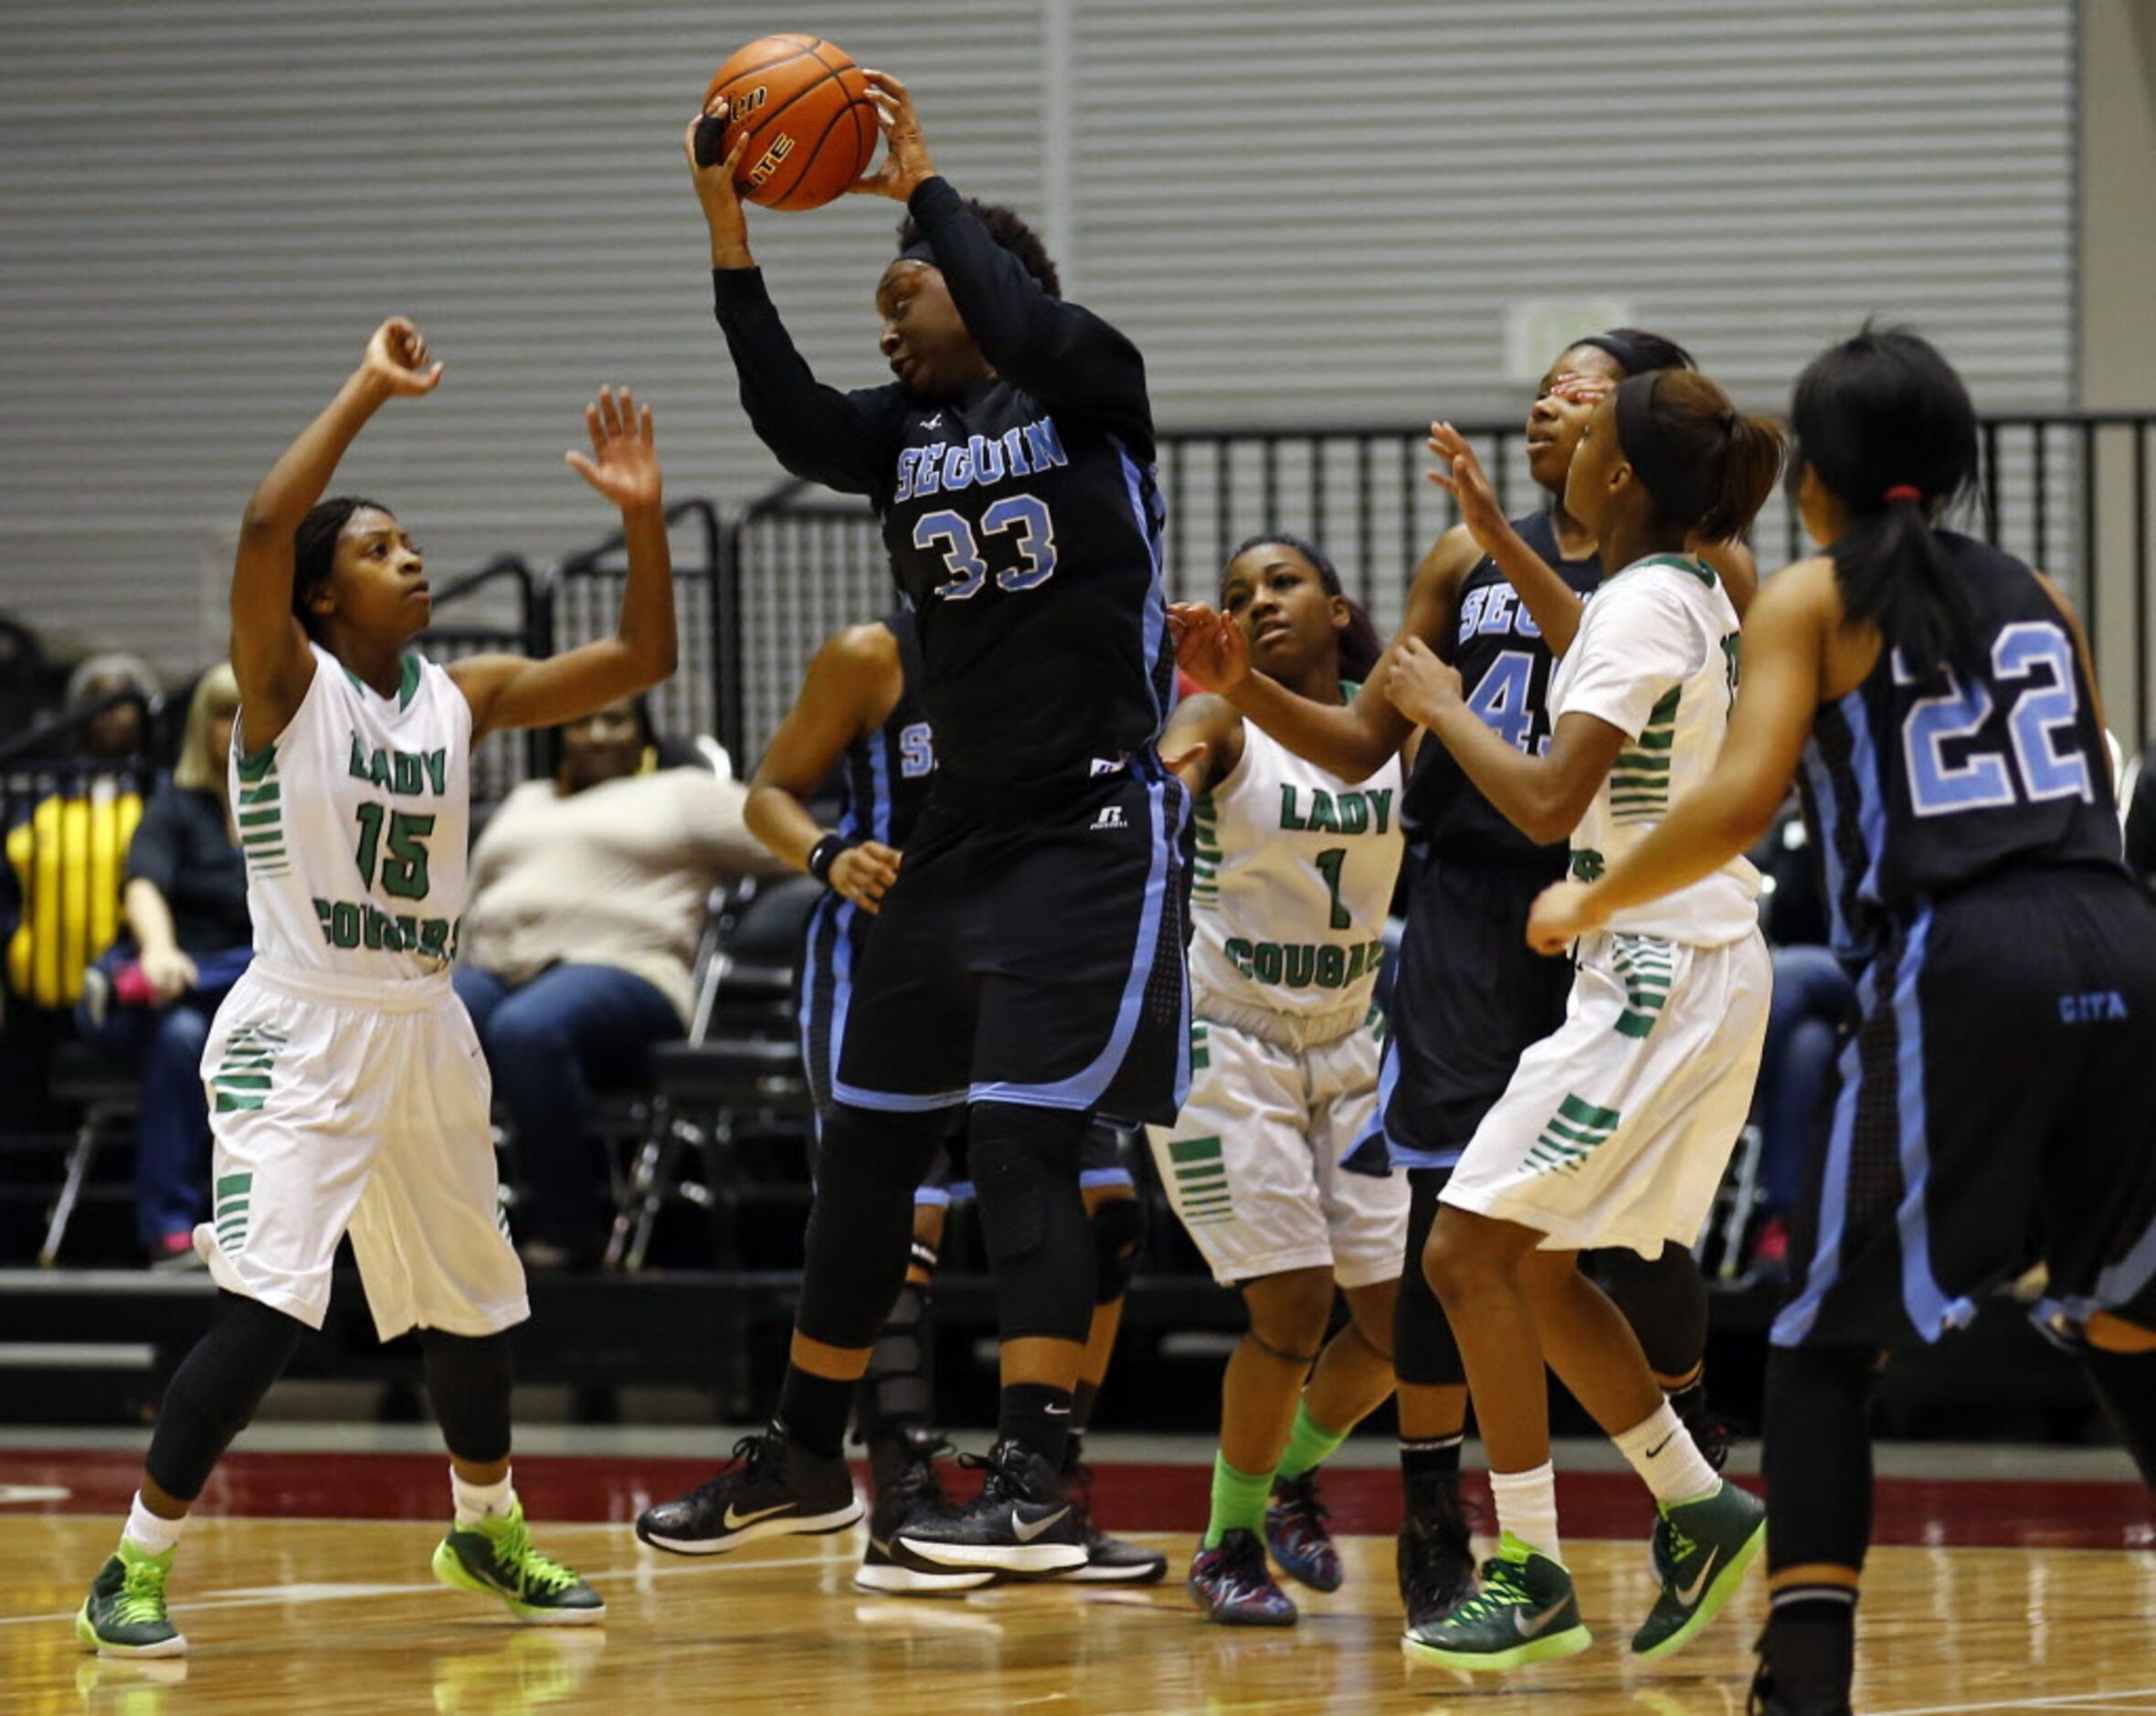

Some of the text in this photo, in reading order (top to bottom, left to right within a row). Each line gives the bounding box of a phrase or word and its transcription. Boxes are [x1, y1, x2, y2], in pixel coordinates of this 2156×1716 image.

[894, 416, 1069, 503] SEGUIN
[913, 493, 1058, 601] 33
[1890, 620, 2095, 818] 22
[349, 731, 446, 796] LADY
[355, 800, 438, 902] 15
[1280, 783, 1394, 835] LADY
[1316, 848, 1352, 930] 1
